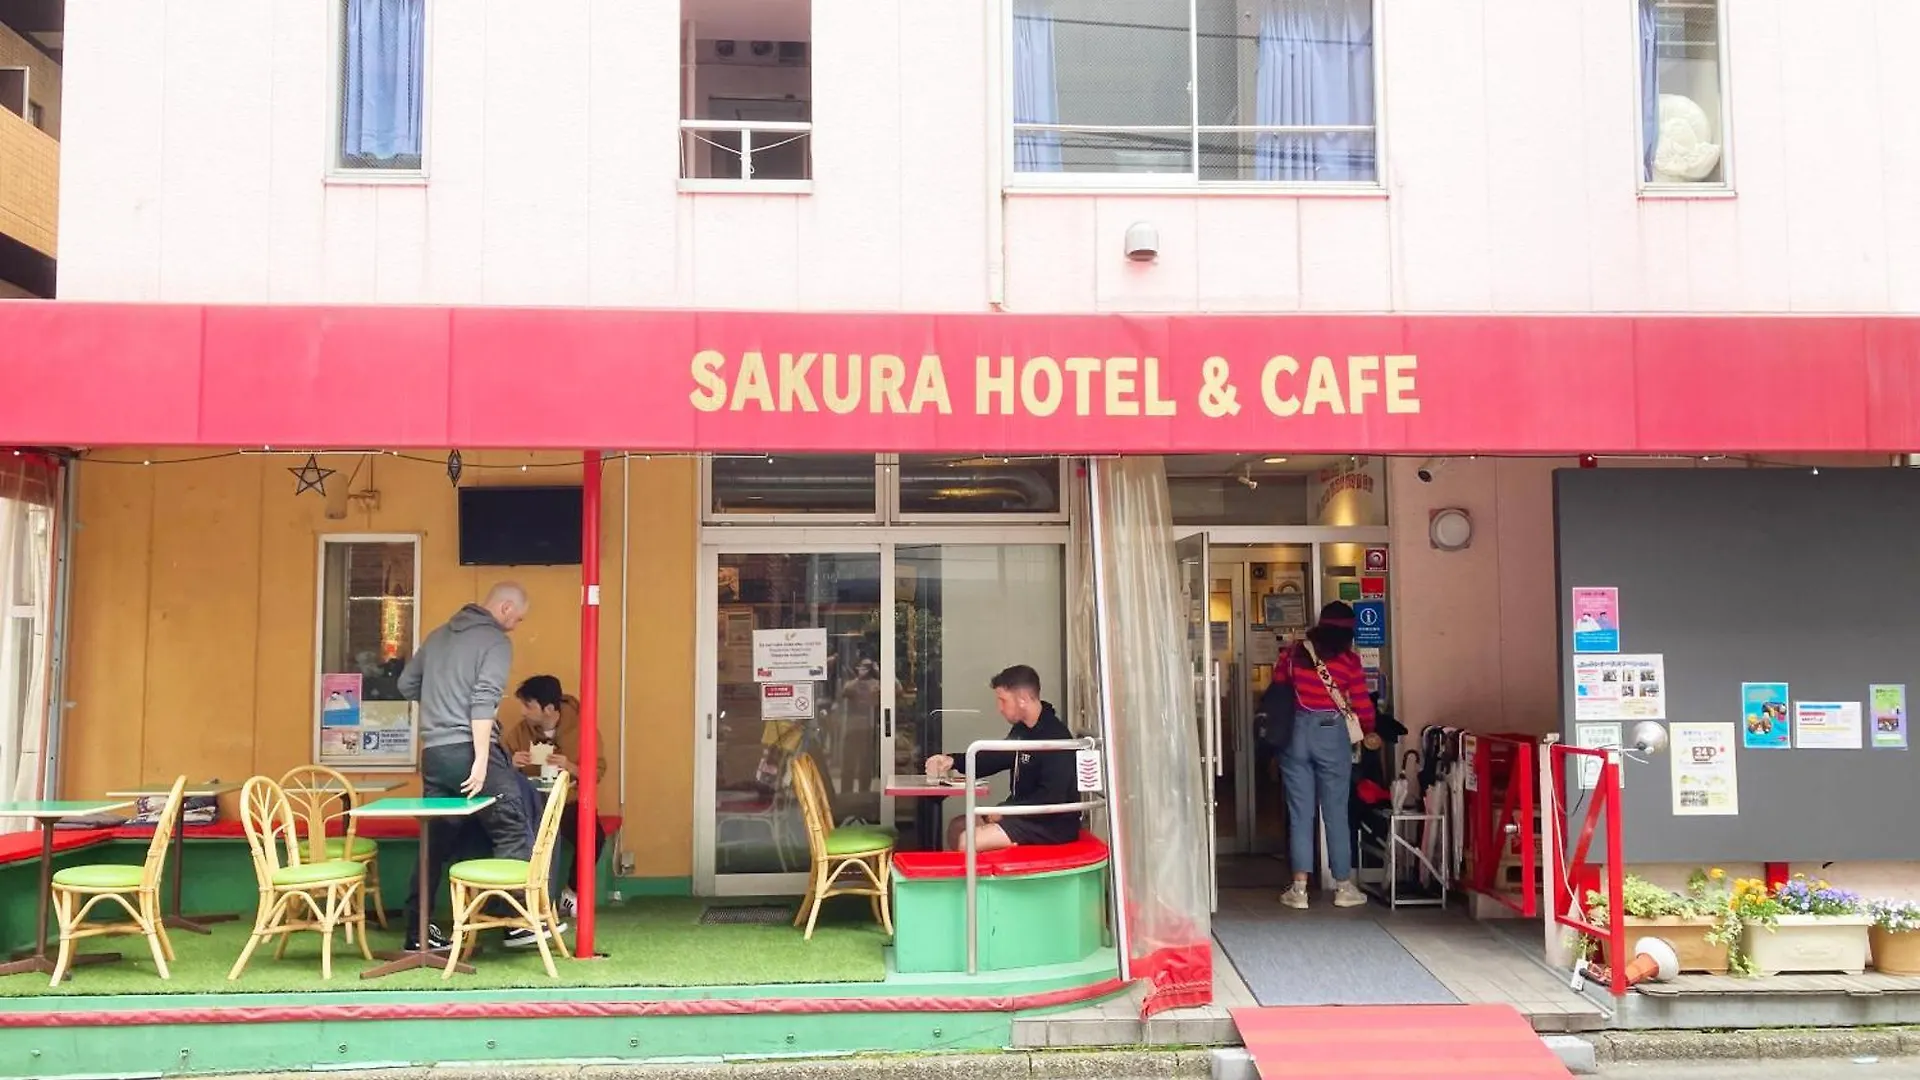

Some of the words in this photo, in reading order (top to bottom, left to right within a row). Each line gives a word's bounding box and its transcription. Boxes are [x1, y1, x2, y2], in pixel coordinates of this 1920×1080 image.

[689, 350, 953, 414] SAKURA
[976, 356, 1177, 417] HOTEL
[1198, 356, 1242, 418] &
[1261, 355, 1421, 417] CAFE
